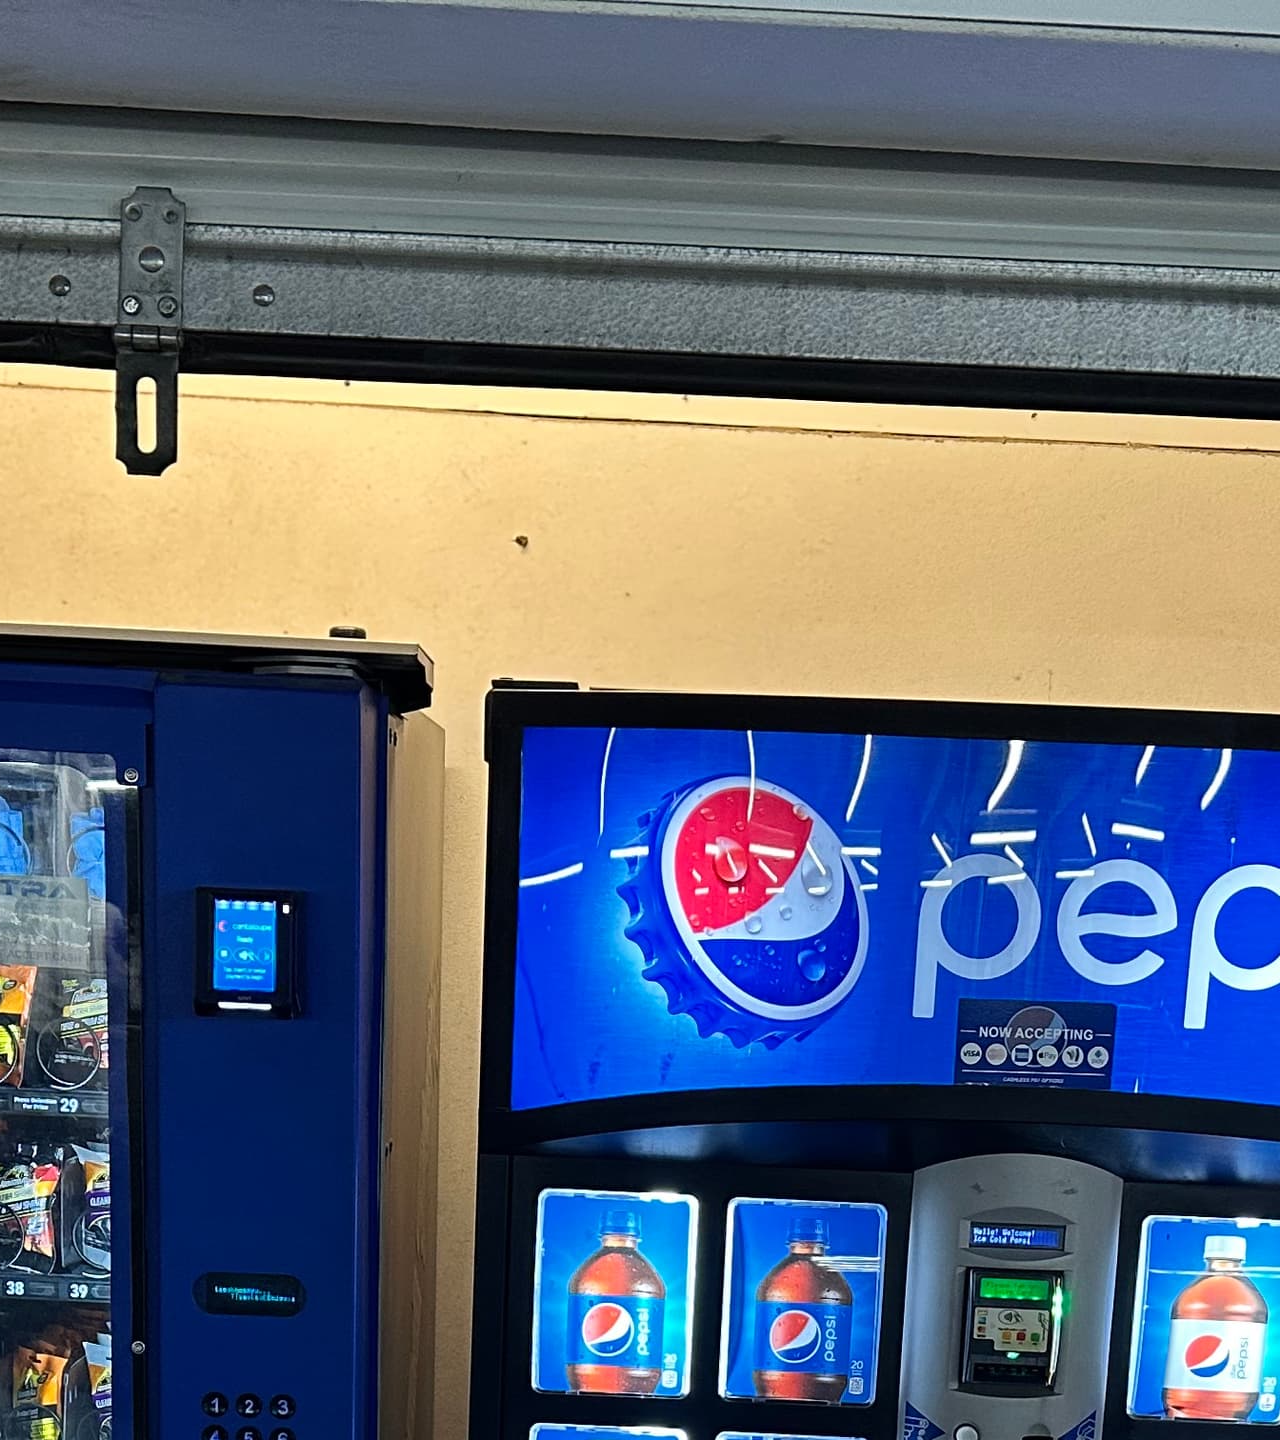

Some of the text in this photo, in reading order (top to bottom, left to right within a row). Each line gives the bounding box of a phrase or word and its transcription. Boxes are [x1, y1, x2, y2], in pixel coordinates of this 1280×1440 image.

[979, 1026, 1094, 1041] NOW ACCEPTING
[963, 1050, 981, 1058] VISA
[59, 1097, 79, 1113] 29
[6, 1280, 25, 1296] 38
[70, 1283, 89, 1299] 39
[636, 1307, 651, 1357] pepsi
[823, 1314, 838, 1363] pepsi
[850, 1360, 865, 1371] 20
[1237, 1336, 1251, 1381] pepsi
[210, 1398, 289, 1415] 1 2 3
